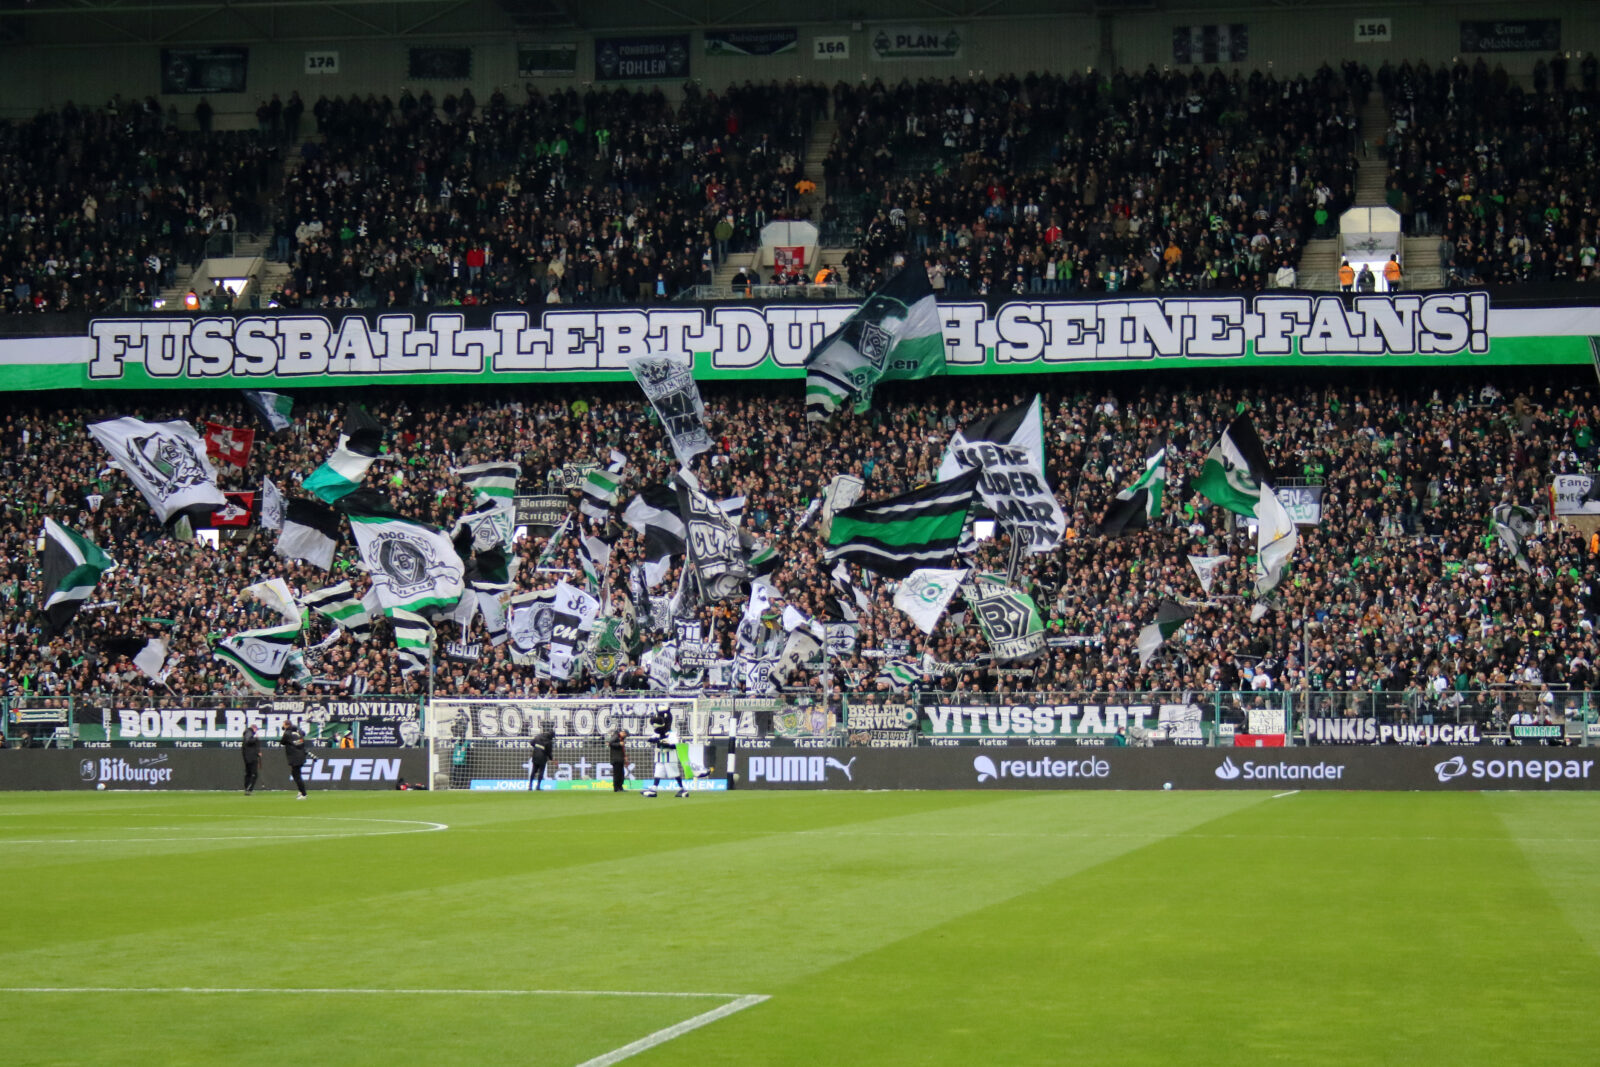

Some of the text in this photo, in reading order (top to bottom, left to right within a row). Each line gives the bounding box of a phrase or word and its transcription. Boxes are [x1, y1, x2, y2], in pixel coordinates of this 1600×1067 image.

[1359, 24, 1387, 36] 15A
[818, 42, 845, 54] 16A
[896, 35, 938, 48] PLAN
[308, 57, 335, 69] 17A
[618, 60, 666, 75] FOHLEN
[89, 291, 1490, 378] FUSSBALL LEBT DUH SEINE FANS!
[327, 702, 417, 716] FRONTLINE
[847, 704, 905, 718] BEGLEIT
[478, 706, 758, 736] SOTTOCUTURA
[924, 705, 1153, 734] VITUSSTADT
[734, 739, 771, 748] flatex
[793, 739, 826, 748] flate
[100, 757, 173, 785] Bitburger
[748, 756, 825, 782] PUMA
[1000, 755, 1110, 778] reuter.de
[1242, 761, 1345, 780] Santander
[1471, 759, 1594, 782] sonepar
